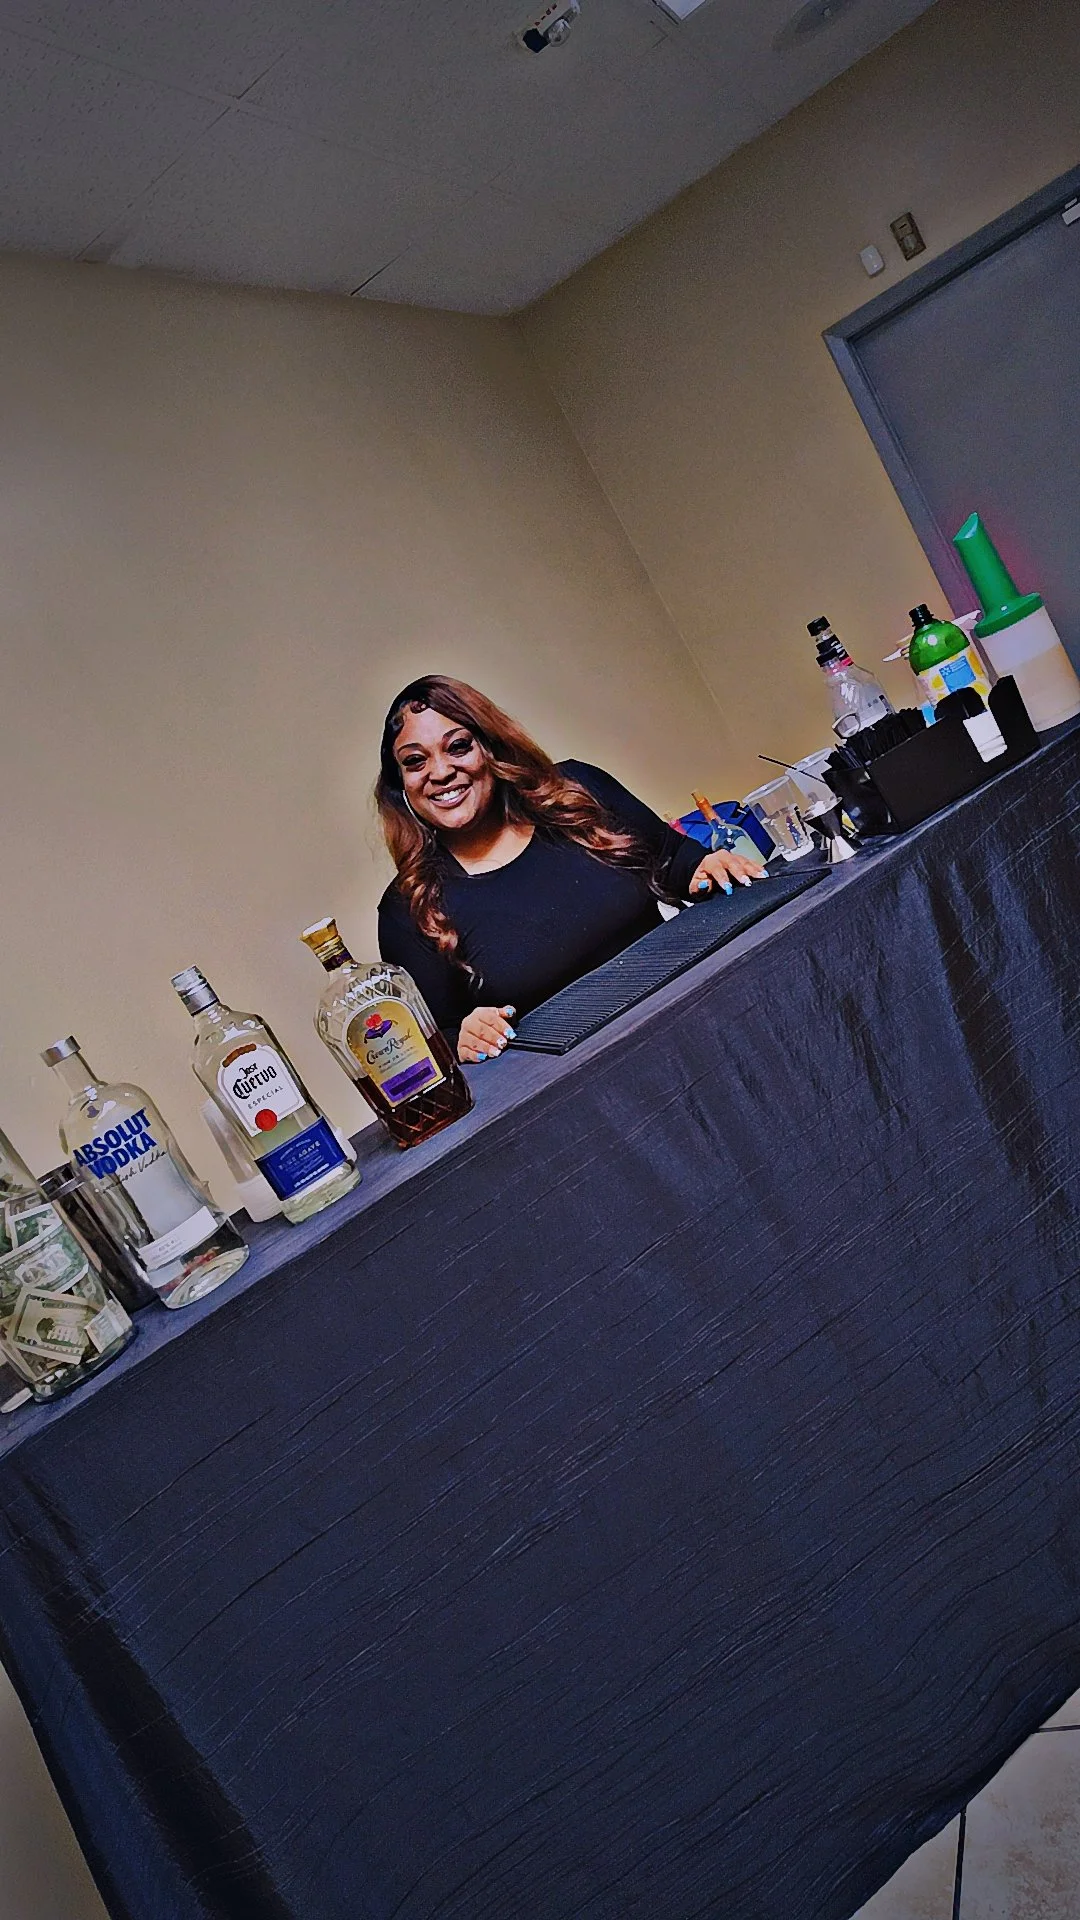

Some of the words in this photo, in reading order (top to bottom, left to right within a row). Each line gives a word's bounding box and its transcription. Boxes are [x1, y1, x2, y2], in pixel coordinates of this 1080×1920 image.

[233, 1066, 277, 1099] Cuervo
[248, 1086, 283, 1109] ESPECIAL
[73, 1108, 151, 1167] ABSOLUT
[88, 1132, 157, 1179] VODKA
